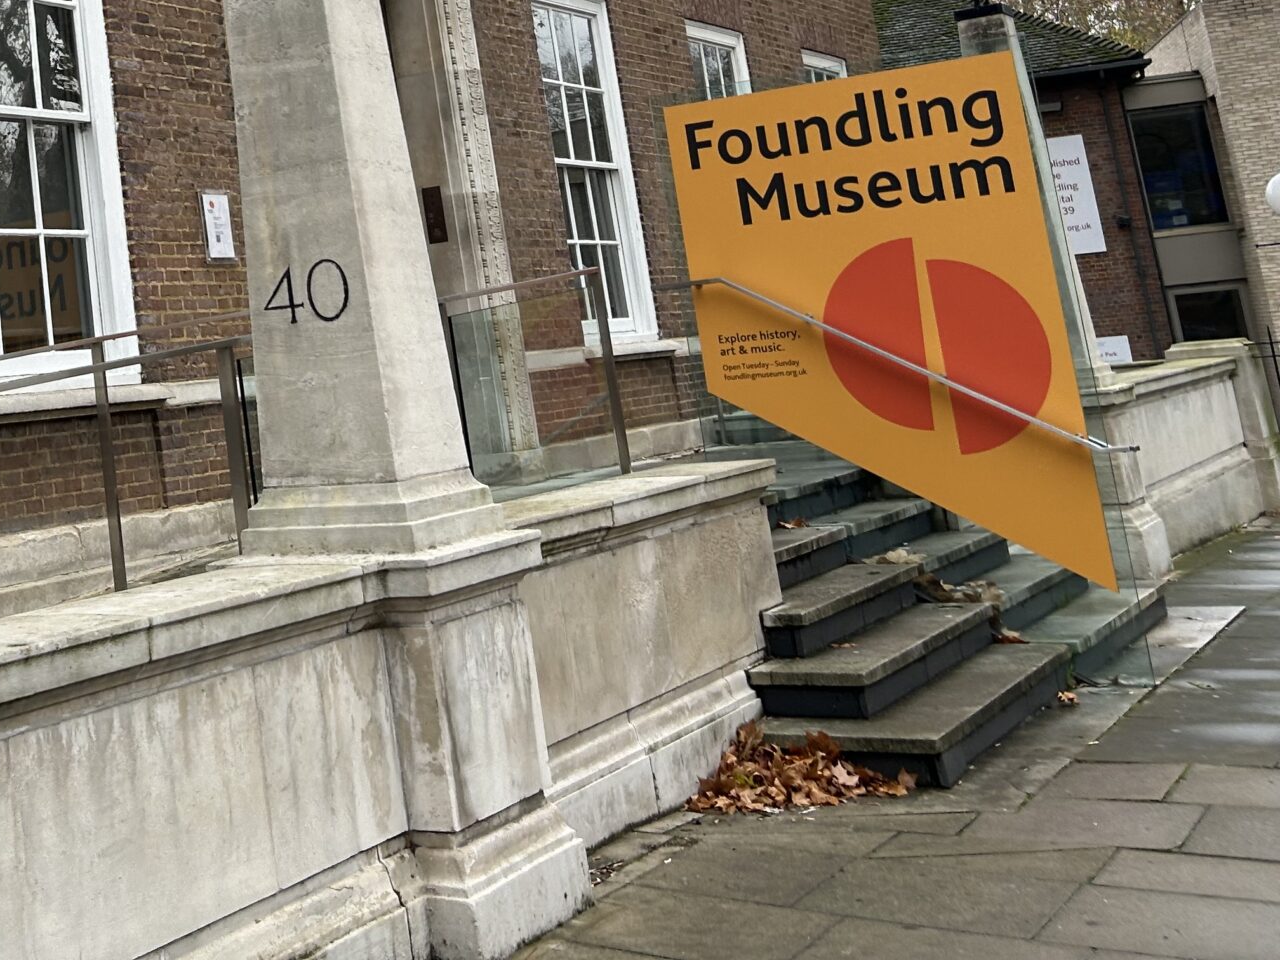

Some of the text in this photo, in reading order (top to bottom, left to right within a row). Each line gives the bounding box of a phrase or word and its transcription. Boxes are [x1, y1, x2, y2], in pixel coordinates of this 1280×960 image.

[685, 87, 1004, 170] Foundling
[736, 155, 1016, 226] Museum
[263, 258, 350, 324] 40
[718, 329, 801, 345] Explore history,
[720, 342, 785, 356] art & music.
[722, 363, 741, 372] Open
[742, 361, 769, 371] Tuesday
[774, 359, 800, 368] Sunday
[724, 368, 808, 381] foundlingmuseum.org.uk
